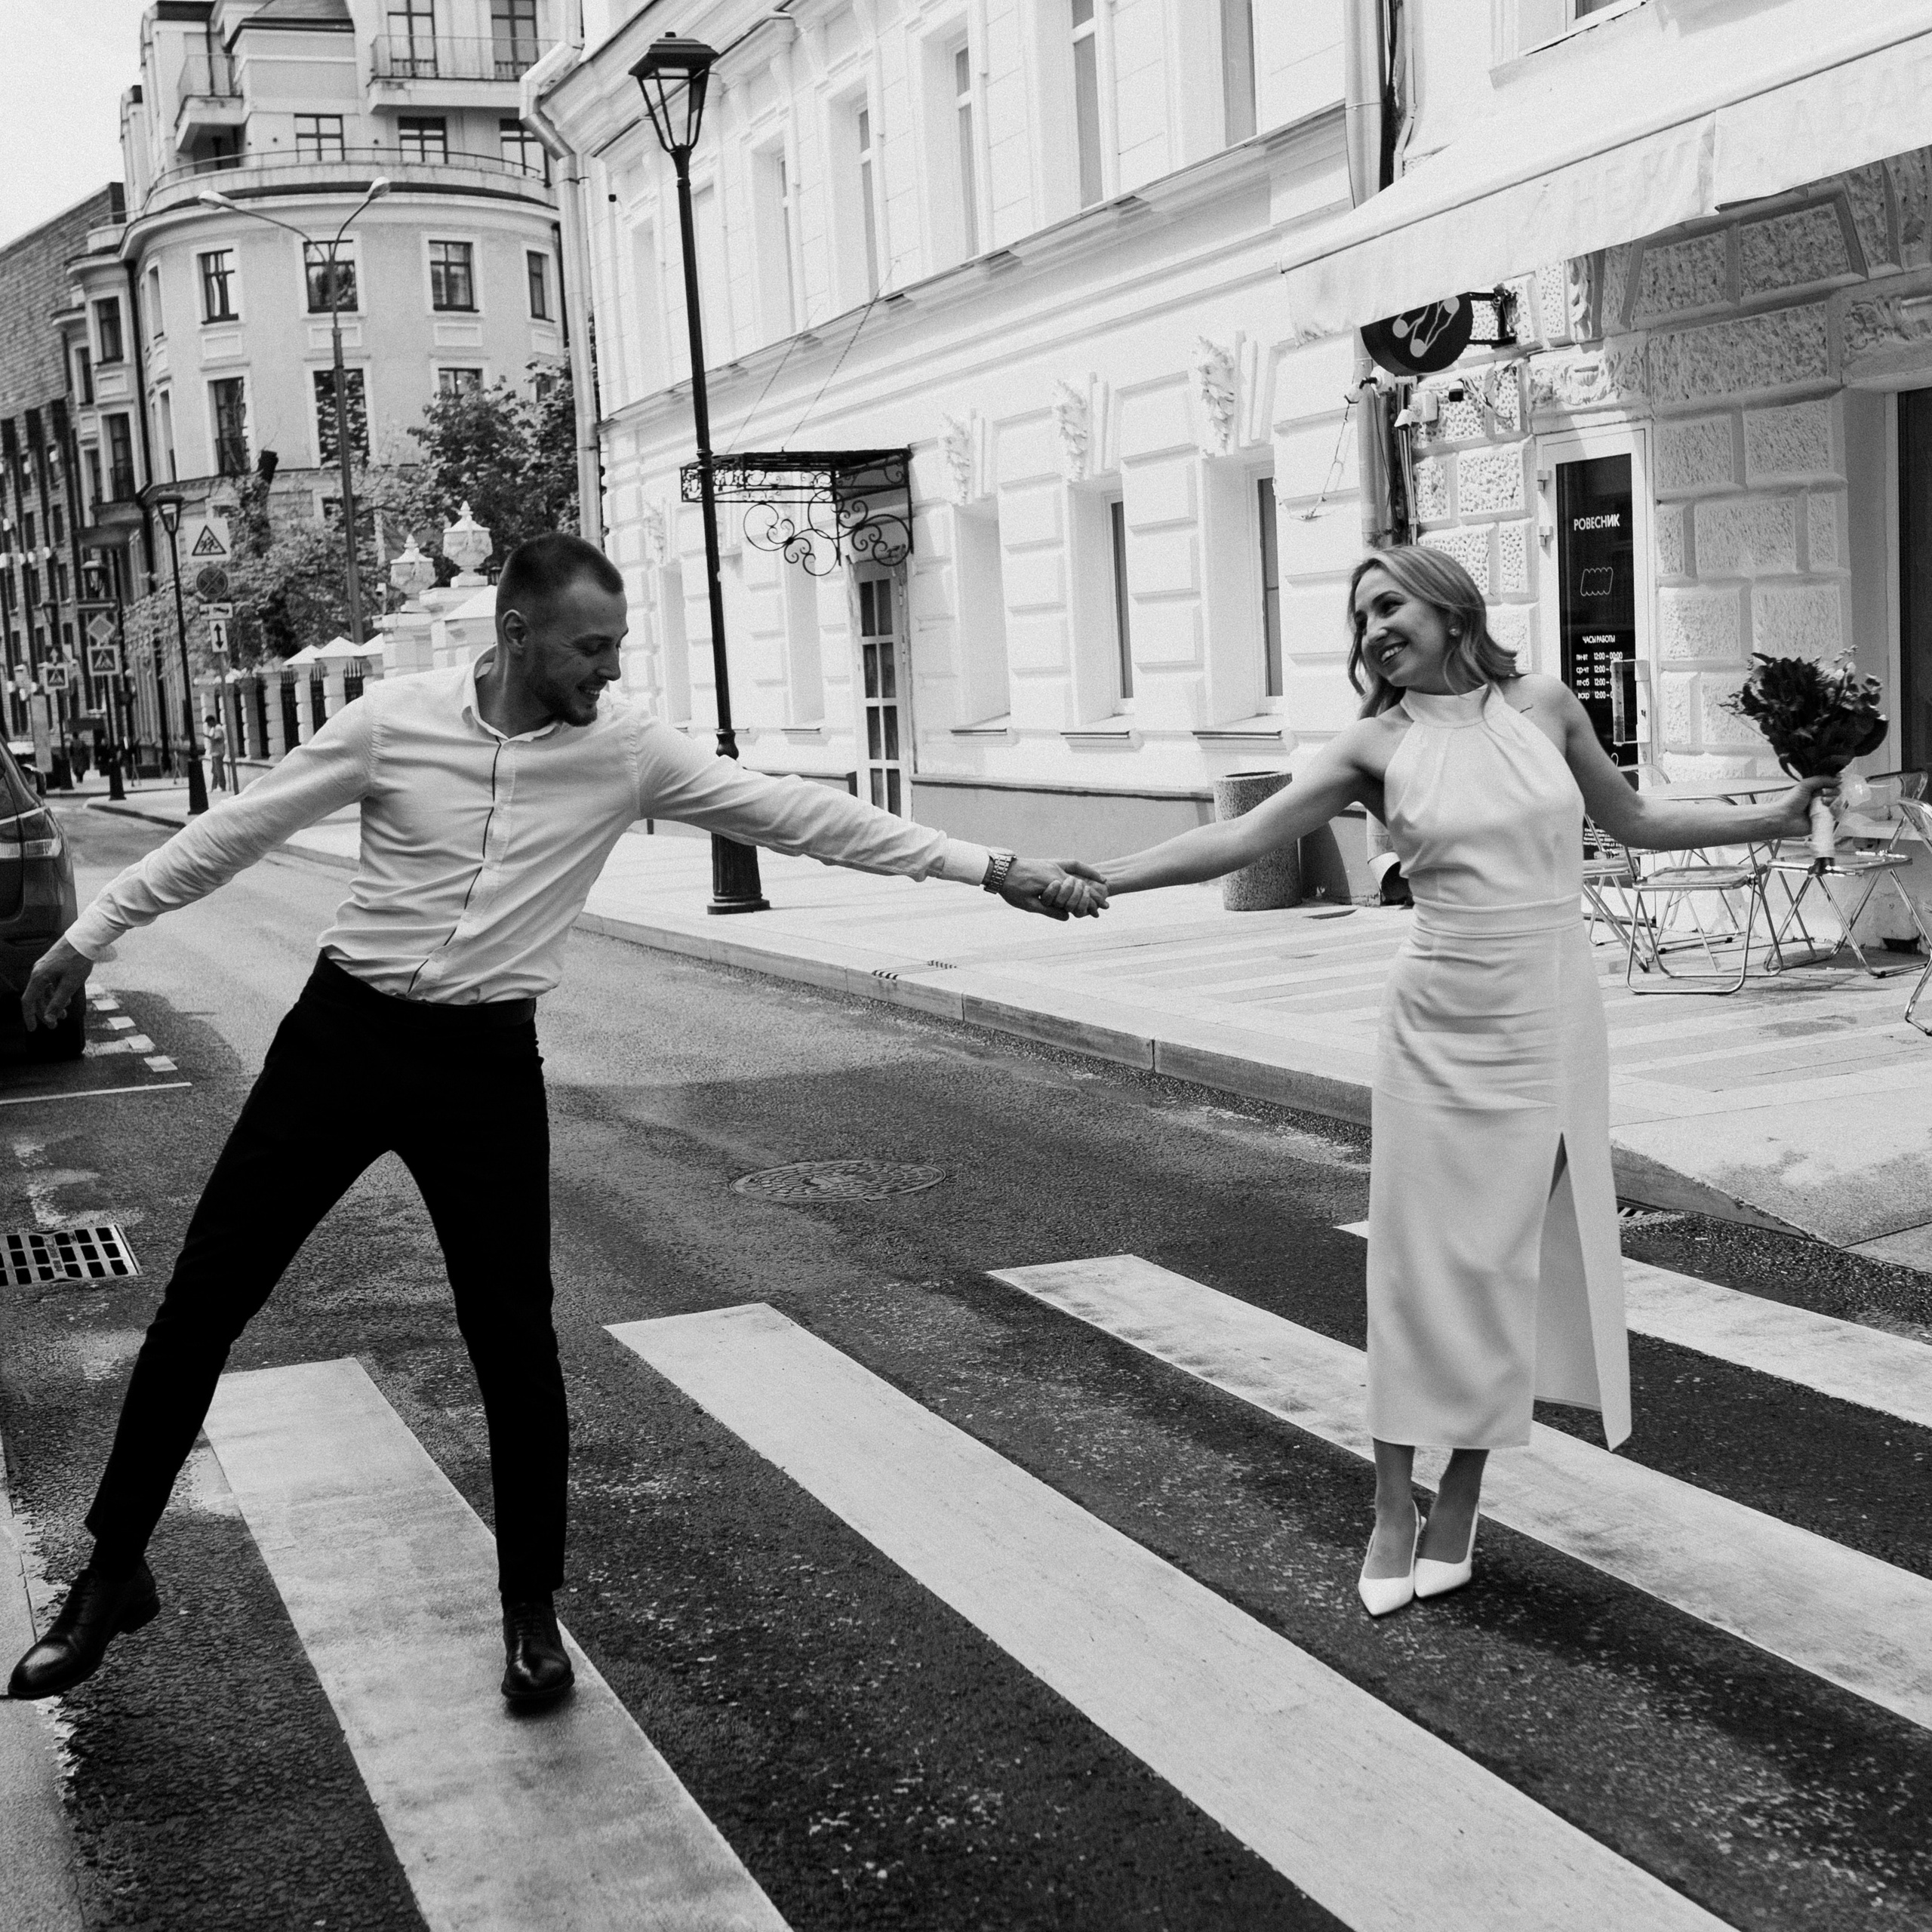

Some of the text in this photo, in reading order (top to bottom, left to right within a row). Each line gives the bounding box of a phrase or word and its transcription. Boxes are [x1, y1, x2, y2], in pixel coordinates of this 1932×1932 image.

[1574, 513, 1620, 531] РОВЕСНИК
[1582, 635, 1616, 644] ЧАСЫ РАБОТЫ
[1593, 652, 1605, 660] 12:00
[1609, 651, 1623, 660] 00:00
[1594, 665, 1605, 673] 12:00
[1594, 678, 1605, 686] 12:00
